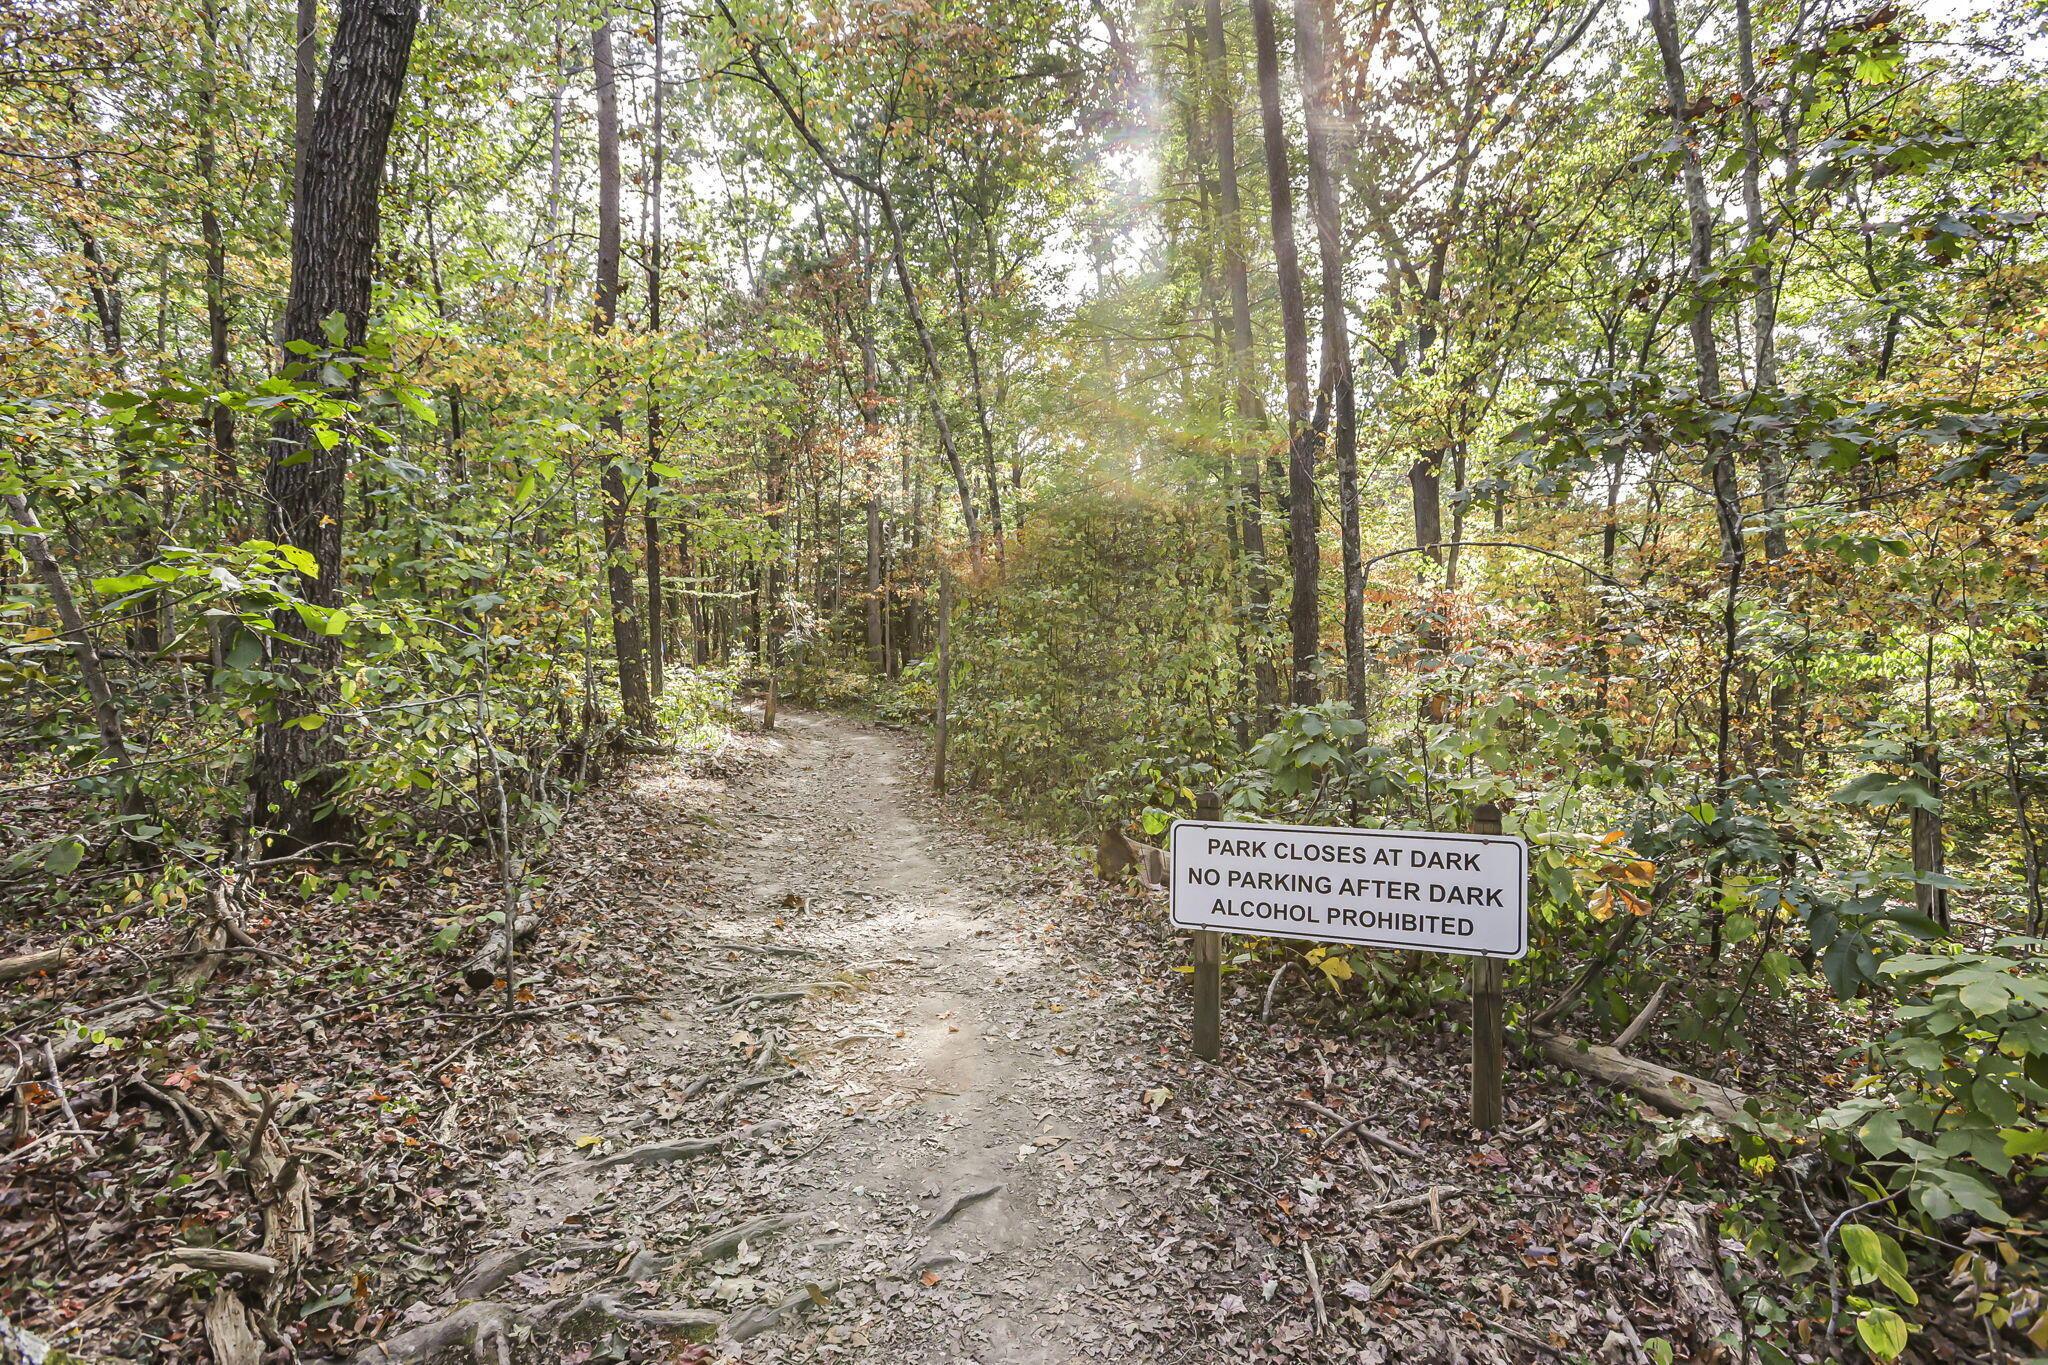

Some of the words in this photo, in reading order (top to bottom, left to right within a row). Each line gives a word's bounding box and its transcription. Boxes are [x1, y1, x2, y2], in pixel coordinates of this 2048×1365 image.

[1209, 839, 1266, 858] PARK
[1274, 843, 1366, 864] CLOSES
[1373, 849, 1402, 866] AT
[1411, 850, 1480, 871] DARK
[1189, 868, 1220, 885] NO
[1229, 871, 1331, 894] PARKING
[1339, 878, 1420, 901] AFTER
[1430, 884, 1503, 907] DARK
[1211, 899, 1319, 923] ALCOHOL
[1328, 908, 1473, 936] PROHIBITED
